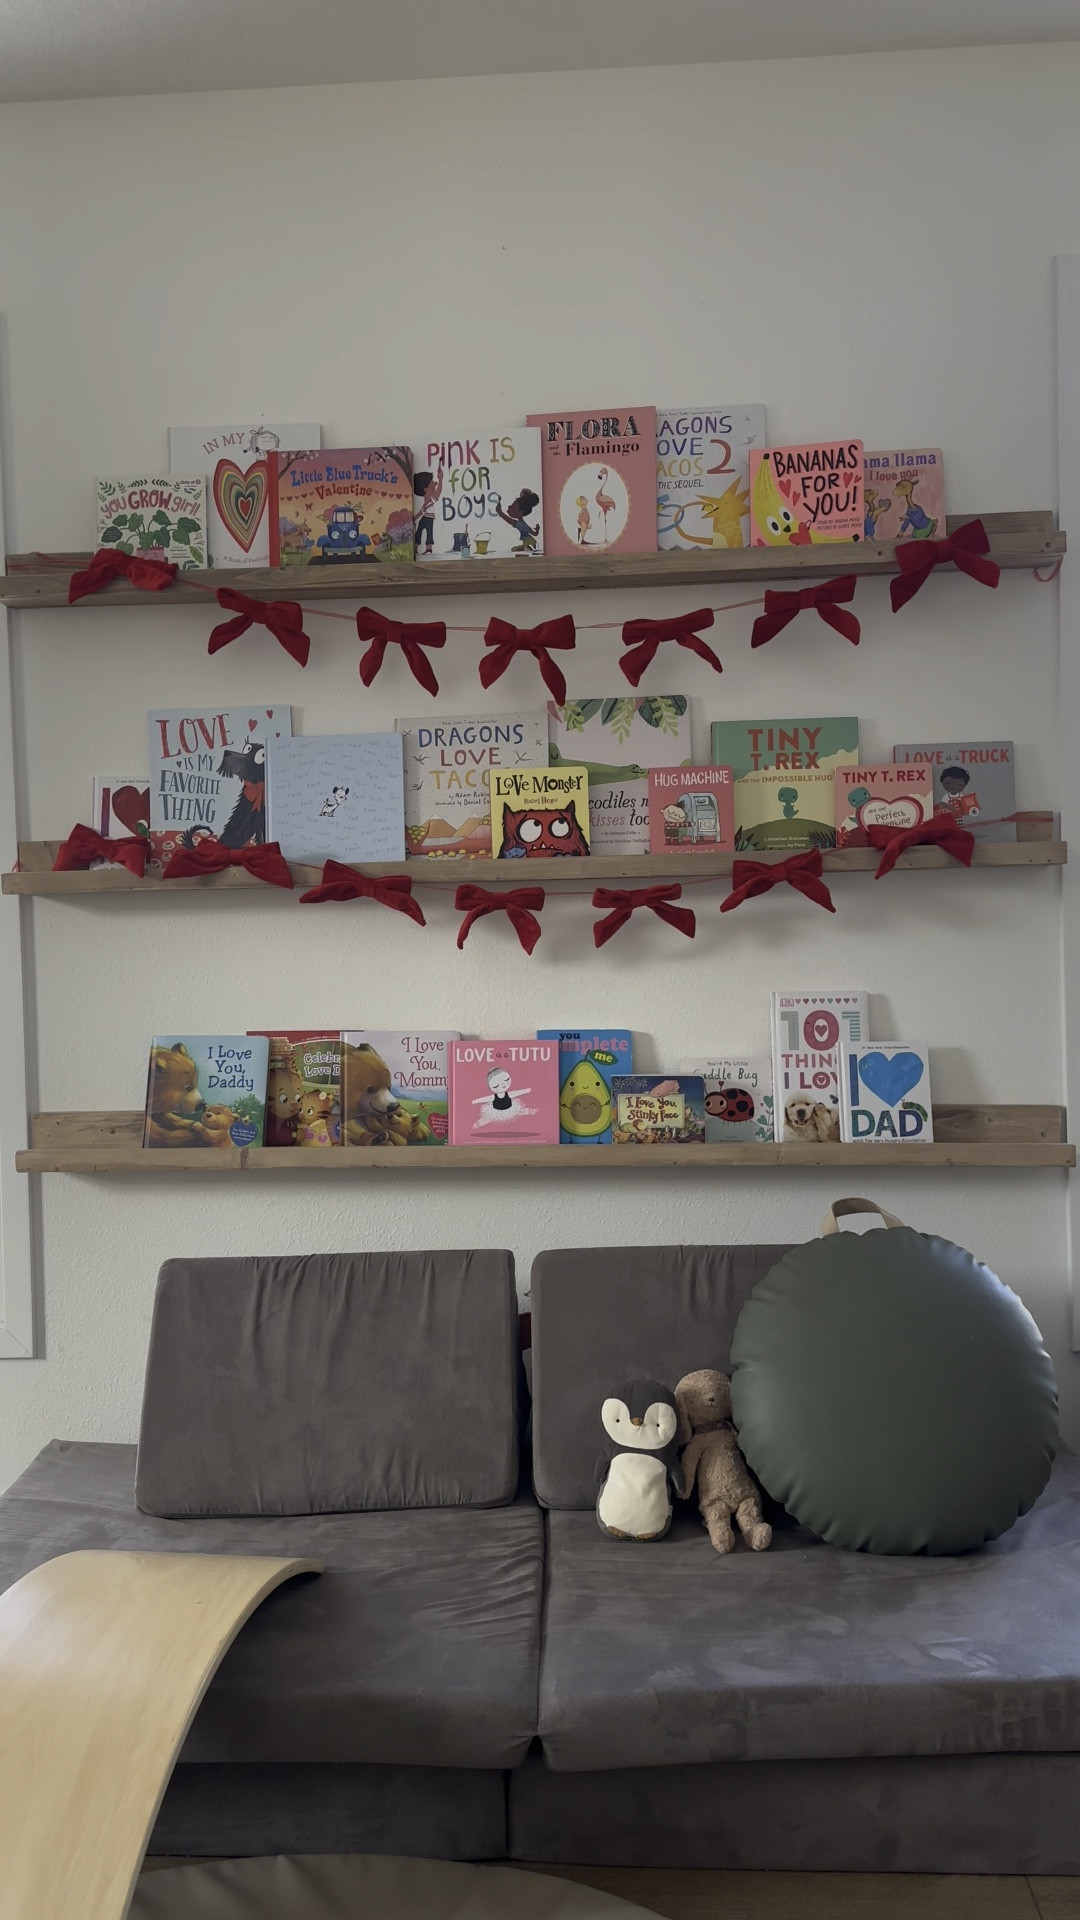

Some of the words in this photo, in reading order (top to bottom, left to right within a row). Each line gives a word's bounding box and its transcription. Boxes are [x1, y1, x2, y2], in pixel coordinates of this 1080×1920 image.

[546, 415, 642, 441] FLORA
[656, 415, 732, 437] AGONS
[202, 438, 220, 454] IN
[222, 432, 245, 446] MY
[566, 440, 640, 457] Flamingo
[656, 437, 704, 456] OVE
[707, 439, 736, 474] 2
[773, 444, 858, 477] BANANAS
[895, 453, 937, 467] llama
[291, 469, 323, 487] Little
[325, 466, 351, 481] Blue
[352, 465, 398, 484] Truck's
[656, 457, 704, 478] ACOS
[876, 472, 898, 481] love
[900, 470, 918, 479] you
[315, 483, 373, 500] Valentine
[658, 481, 672, 489] THE
[673, 479, 704, 489] SEQUEL
[802, 473, 840, 498] FOR
[803, 486, 857, 522] YOU!
[155, 713, 234, 759] LOVE
[418, 724, 524, 748] DRAGONS
[748, 727, 822, 752] TINY
[183, 756, 193, 771] IS
[197, 754, 216, 771] MY
[440, 747, 501, 767] LOVE
[751, 753, 770, 771] T.
[776, 752, 820, 771] REX
[906, 751, 944, 764] LOVE
[959, 748, 1010, 764] TRUCK
[159, 770, 221, 795] FAVORITE
[429, 768, 490, 790] TACO
[655, 773, 678, 787] HUG
[681, 770, 730, 786] MACHINE
[762, 775, 813, 783] IMPOSSIBLE
[814, 774, 833, 782] HUG
[842, 771, 877, 784] TINY
[881, 770, 893, 782] T.
[897, 769, 926, 782] REX
[588, 790, 636, 809] codiles
[158, 794, 216, 823] THING
[559, 1032, 580, 1041] you
[780, 1010, 861, 1051] 101
[207, 1046, 213, 1059] I
[218, 1044, 252, 1060] Love
[401, 1036, 410, 1052] I
[414, 1036, 444, 1053] Love
[559, 1037, 628, 1055] mplete
[304, 1052, 340, 1064] Celebr
[410, 1055, 441, 1072] You,
[456, 1047, 493, 1063] LOVE
[495, 1050, 502, 1058] is
[508, 1047, 551, 1062] TUTU
[594, 1052, 613, 1063] me
[781, 1053, 837, 1068] THIN
[215, 1060, 246, 1075] You,
[304, 1065, 330, 1078] Love
[207, 1075, 254, 1091] Daddy
[394, 1071, 448, 1089] Momm
[694, 1068, 732, 1080] uddle
[738, 1067, 758, 1087] Bug
[784, 1072, 789, 1089] I
[849, 1054, 859, 1106] I
[626, 1096, 633, 1108] I
[627, 1109, 659, 1124] Stinky
[851, 1109, 923, 1138] DAD
